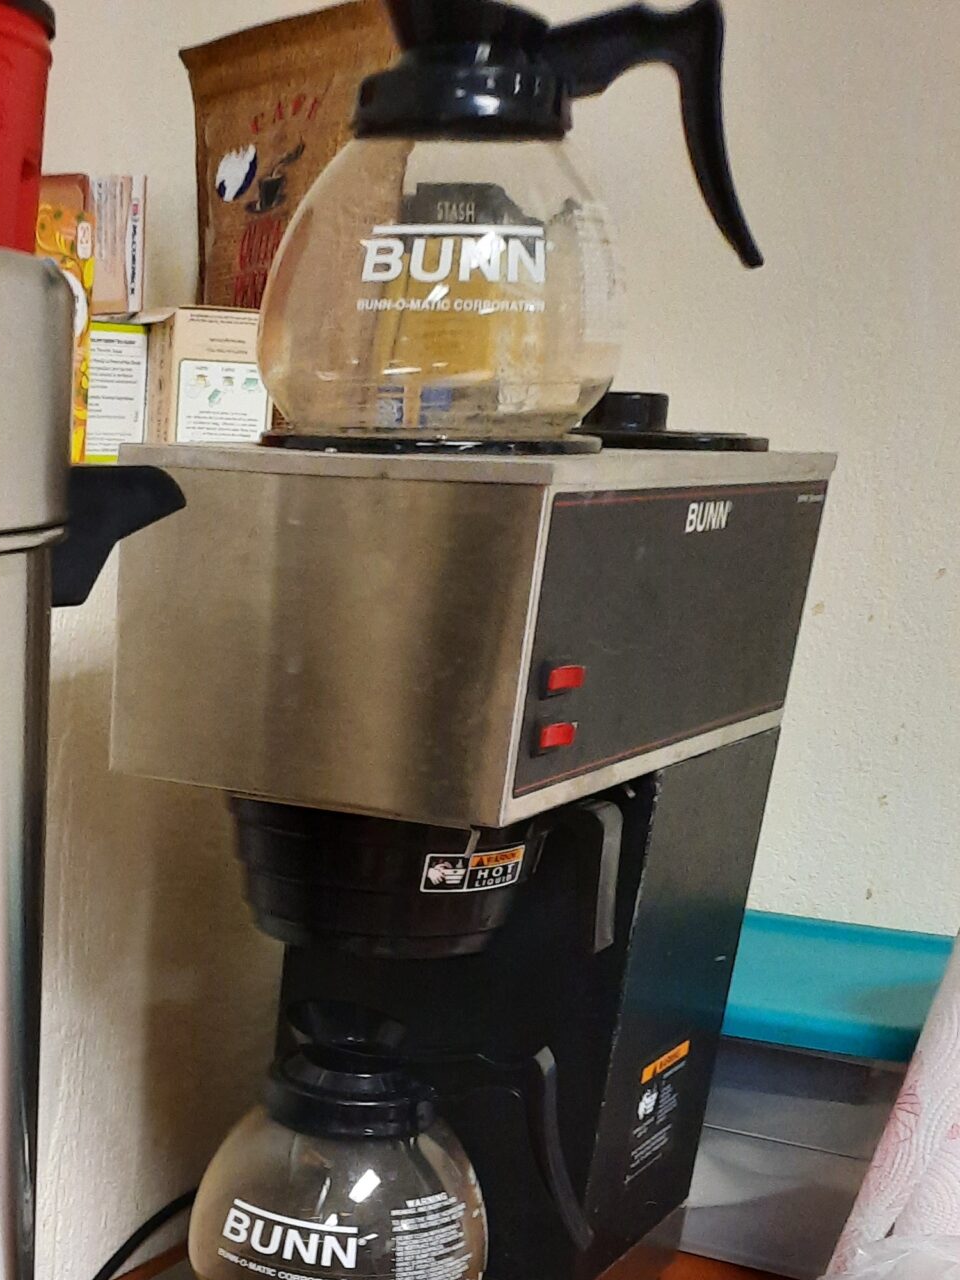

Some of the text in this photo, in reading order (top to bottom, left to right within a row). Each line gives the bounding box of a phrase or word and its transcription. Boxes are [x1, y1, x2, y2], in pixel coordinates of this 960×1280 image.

[436, 201, 476, 222] STASH
[361, 237, 546, 284] BUNN
[357, 297, 546, 313] BUNN-O-MATIC CORPORATION
[685, 500, 729, 533] BUNN
[475, 875, 513, 887] LIQUID
[477, 864, 516, 879] HOT
[222, 1207, 357, 1269] BUNN
[217, 1247, 277, 1277] BUNN-O-MATIC
